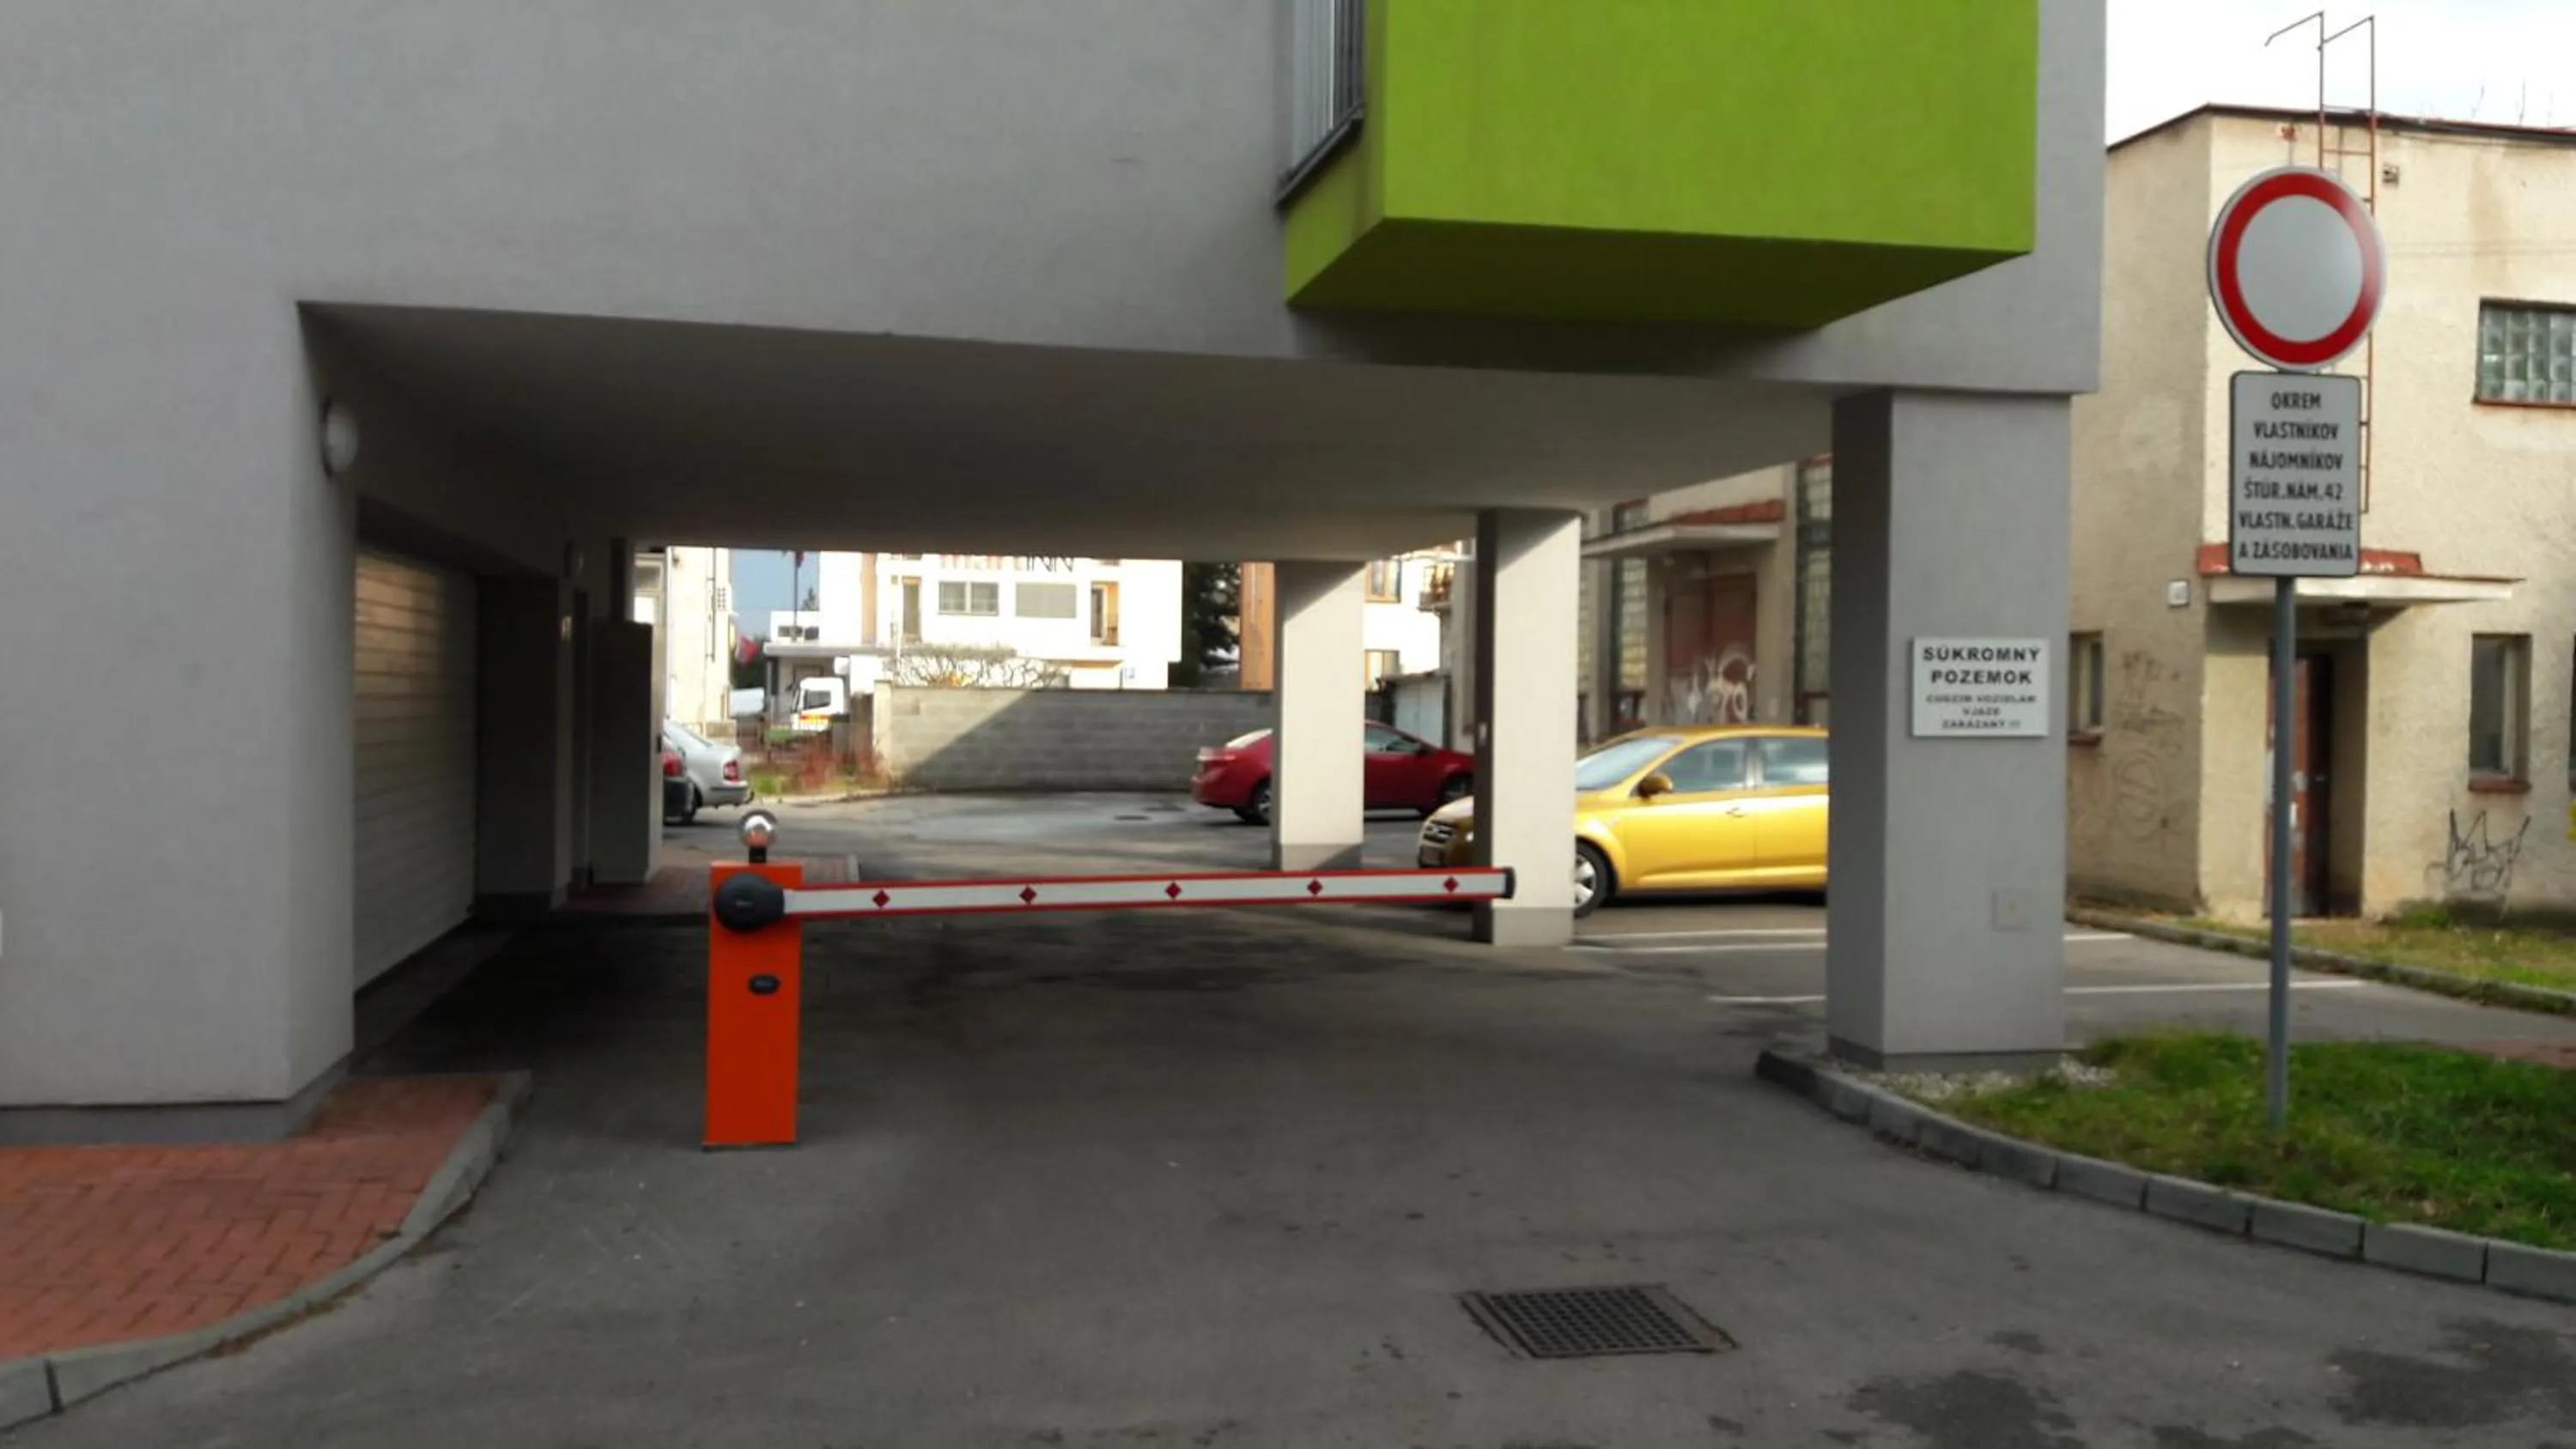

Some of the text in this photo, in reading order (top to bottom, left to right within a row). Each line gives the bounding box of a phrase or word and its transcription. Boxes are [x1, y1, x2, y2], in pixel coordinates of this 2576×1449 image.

[2271, 392, 2321, 409] OKREM
[2239, 542, 2249, 559] A
[1923, 646, 2040, 662] SÚKROMNÝ
[1931, 670, 2032, 684] POZEMOK
